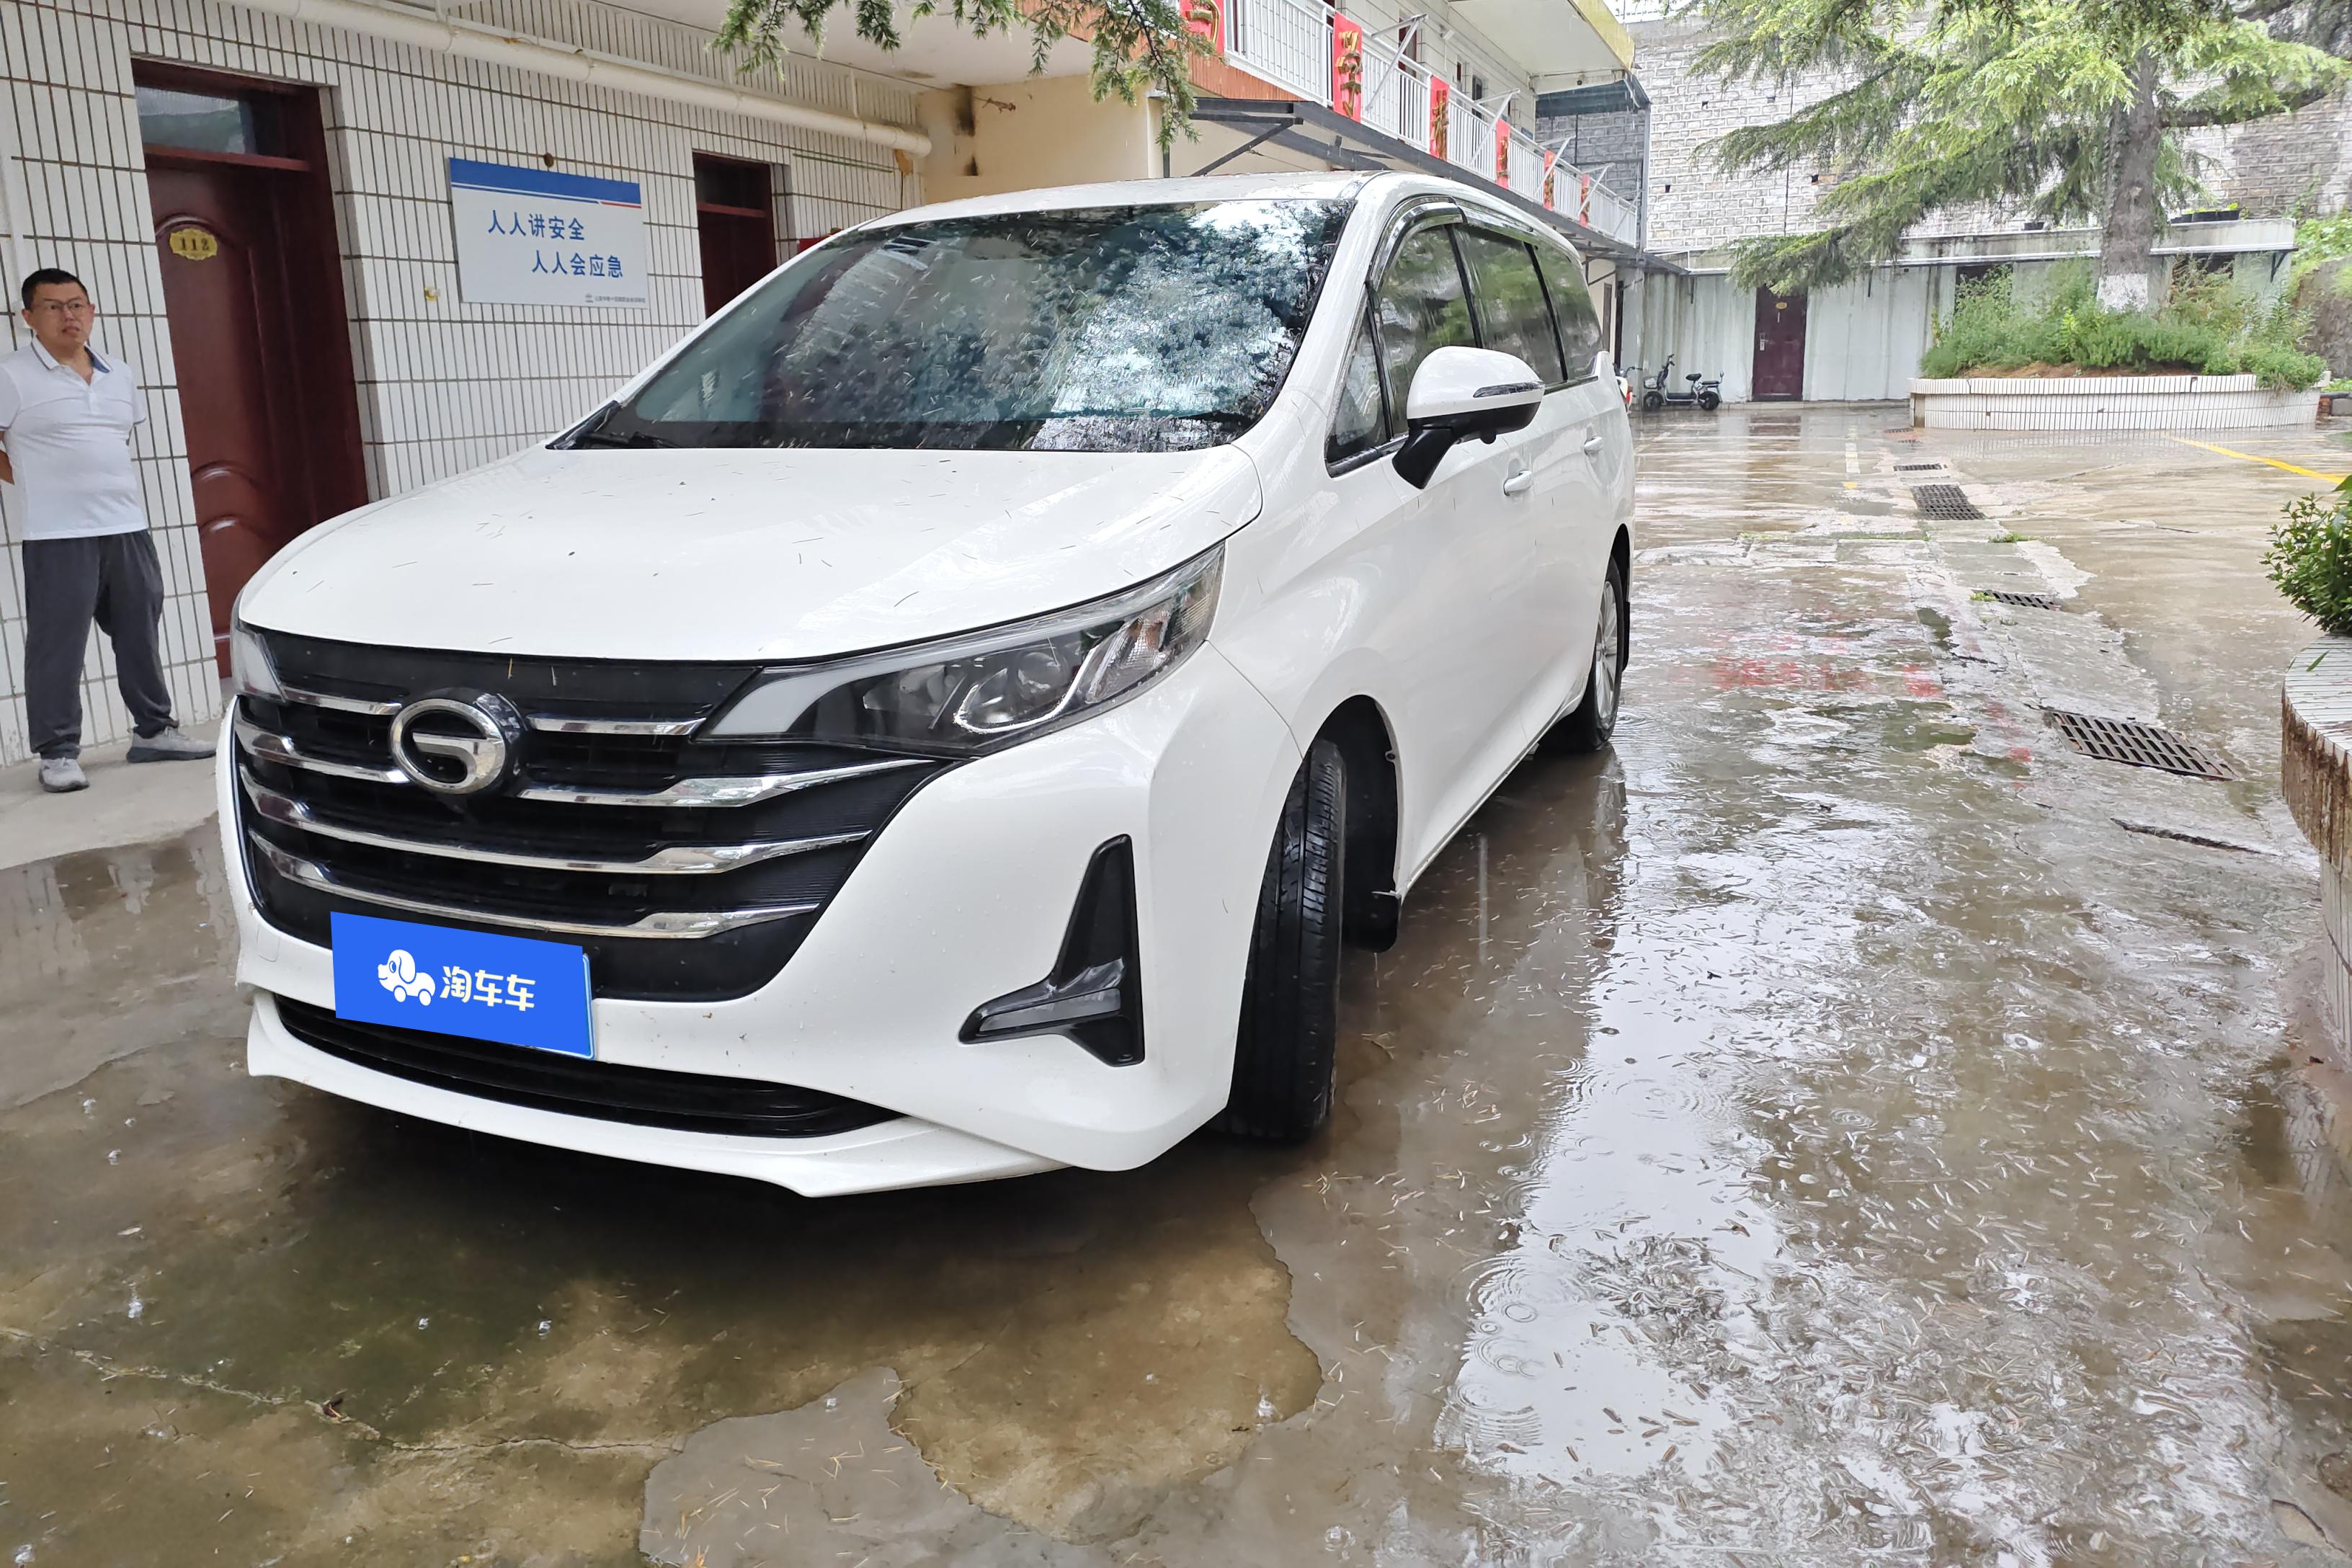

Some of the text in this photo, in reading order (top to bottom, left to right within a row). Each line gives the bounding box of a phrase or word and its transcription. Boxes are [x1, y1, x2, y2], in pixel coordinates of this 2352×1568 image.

[488, 210, 584, 241] 人人讲安全
[181, 236, 210, 251] 112
[532, 250, 623, 278] 人人会应急
